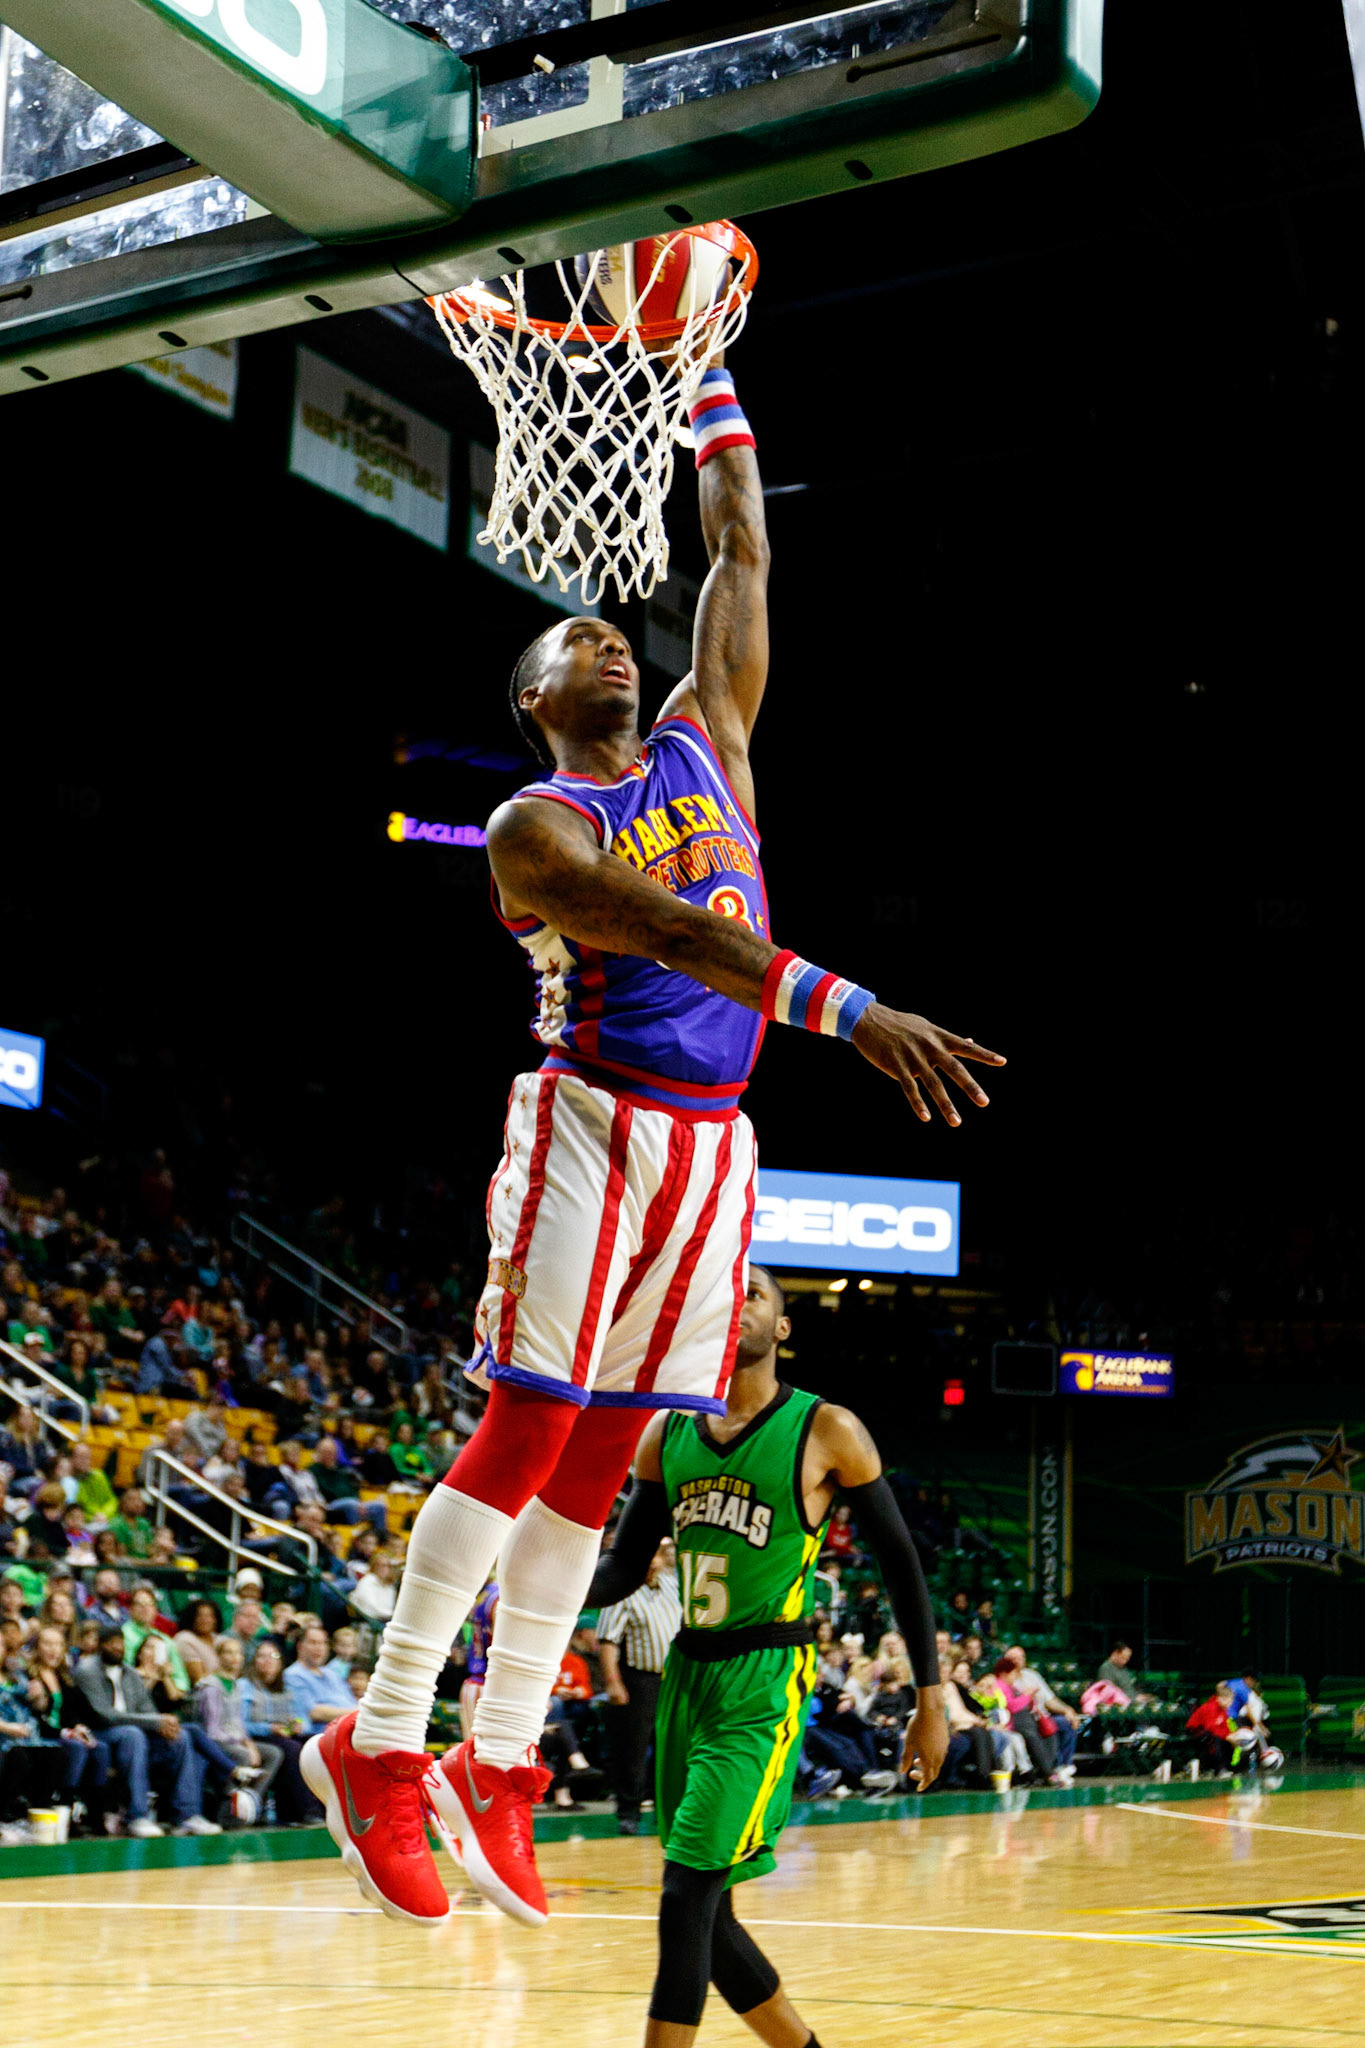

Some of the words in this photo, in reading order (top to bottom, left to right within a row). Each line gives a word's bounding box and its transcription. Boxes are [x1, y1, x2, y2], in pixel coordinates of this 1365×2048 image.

[612, 794, 733, 871] HARLEM
[751, 1196, 952, 1252] GEICO
[680, 1476, 752, 1500] WASHGTON
[1191, 1492, 1361, 1553] MASON
[1225, 1541, 1329, 1562] PATRIOTS
[679, 1550, 730, 1629] 15
